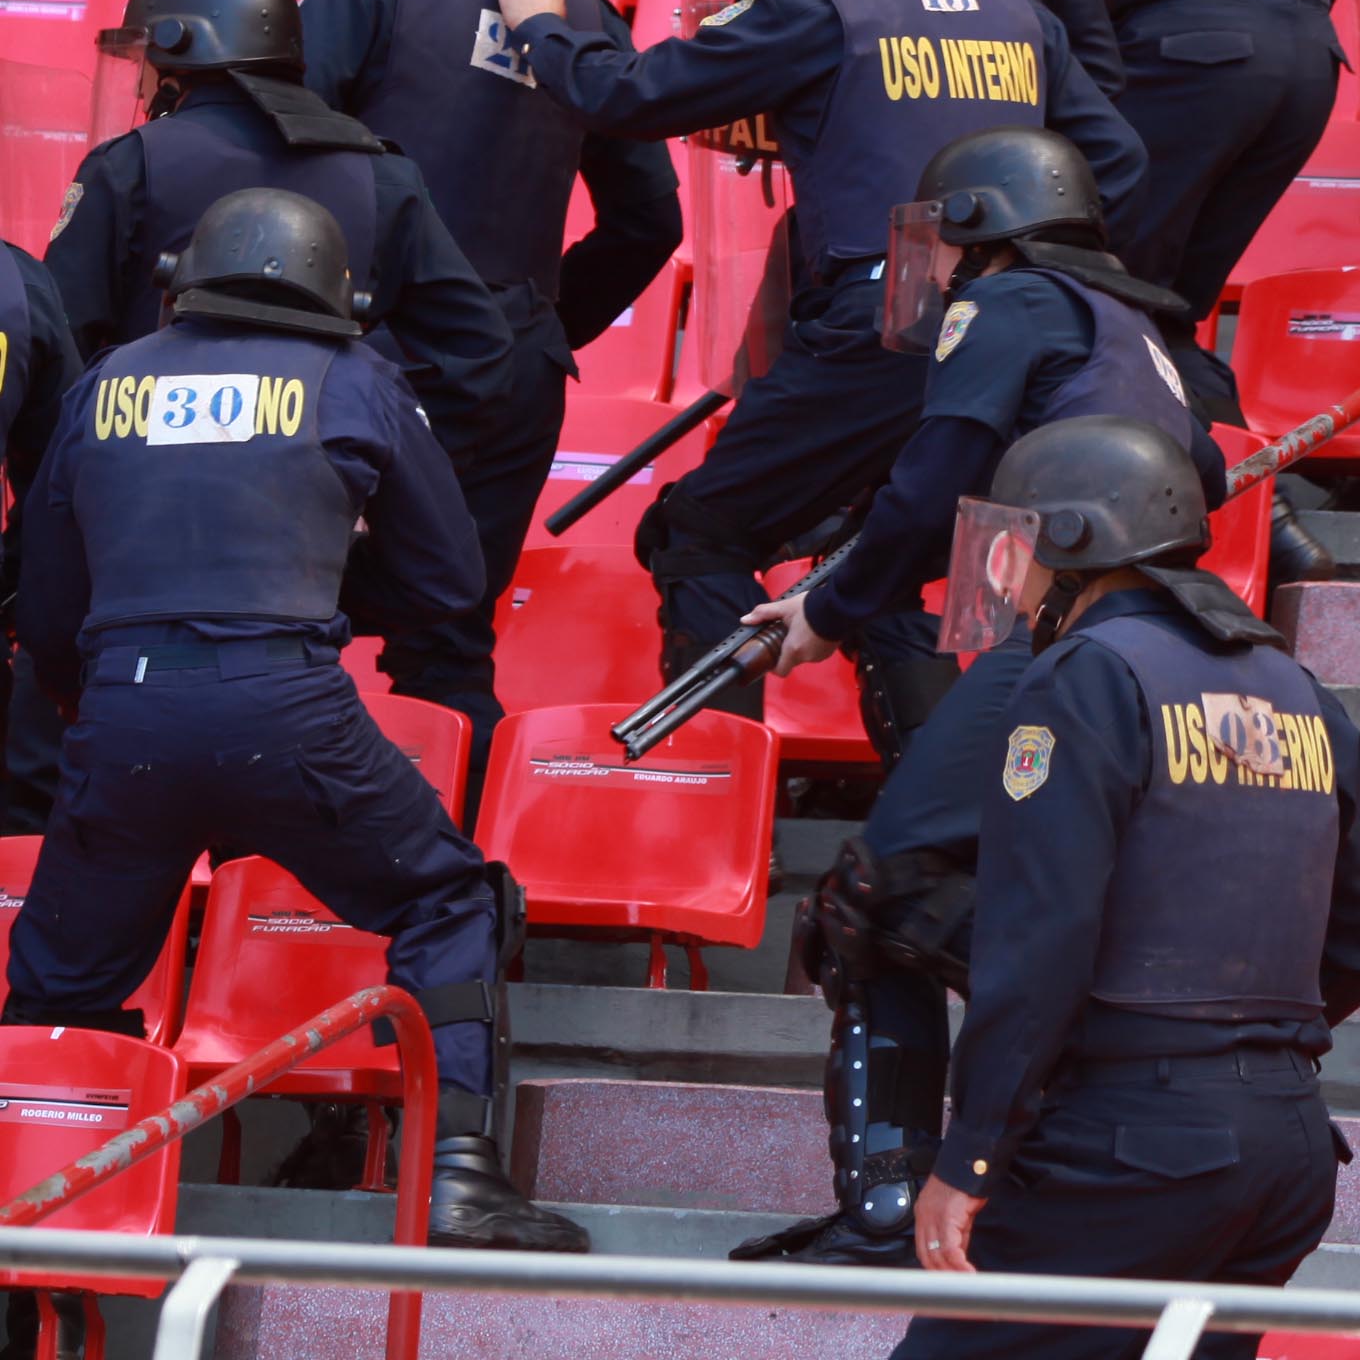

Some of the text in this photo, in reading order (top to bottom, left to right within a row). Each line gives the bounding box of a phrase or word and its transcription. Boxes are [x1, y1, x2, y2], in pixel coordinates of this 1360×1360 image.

[879, 37, 1038, 106] USO INTERNO
[162, 385, 243, 429] 30
[1219, 711, 1281, 764] 03
[20, 1108, 103, 1122] ROGERIO MILLEO
